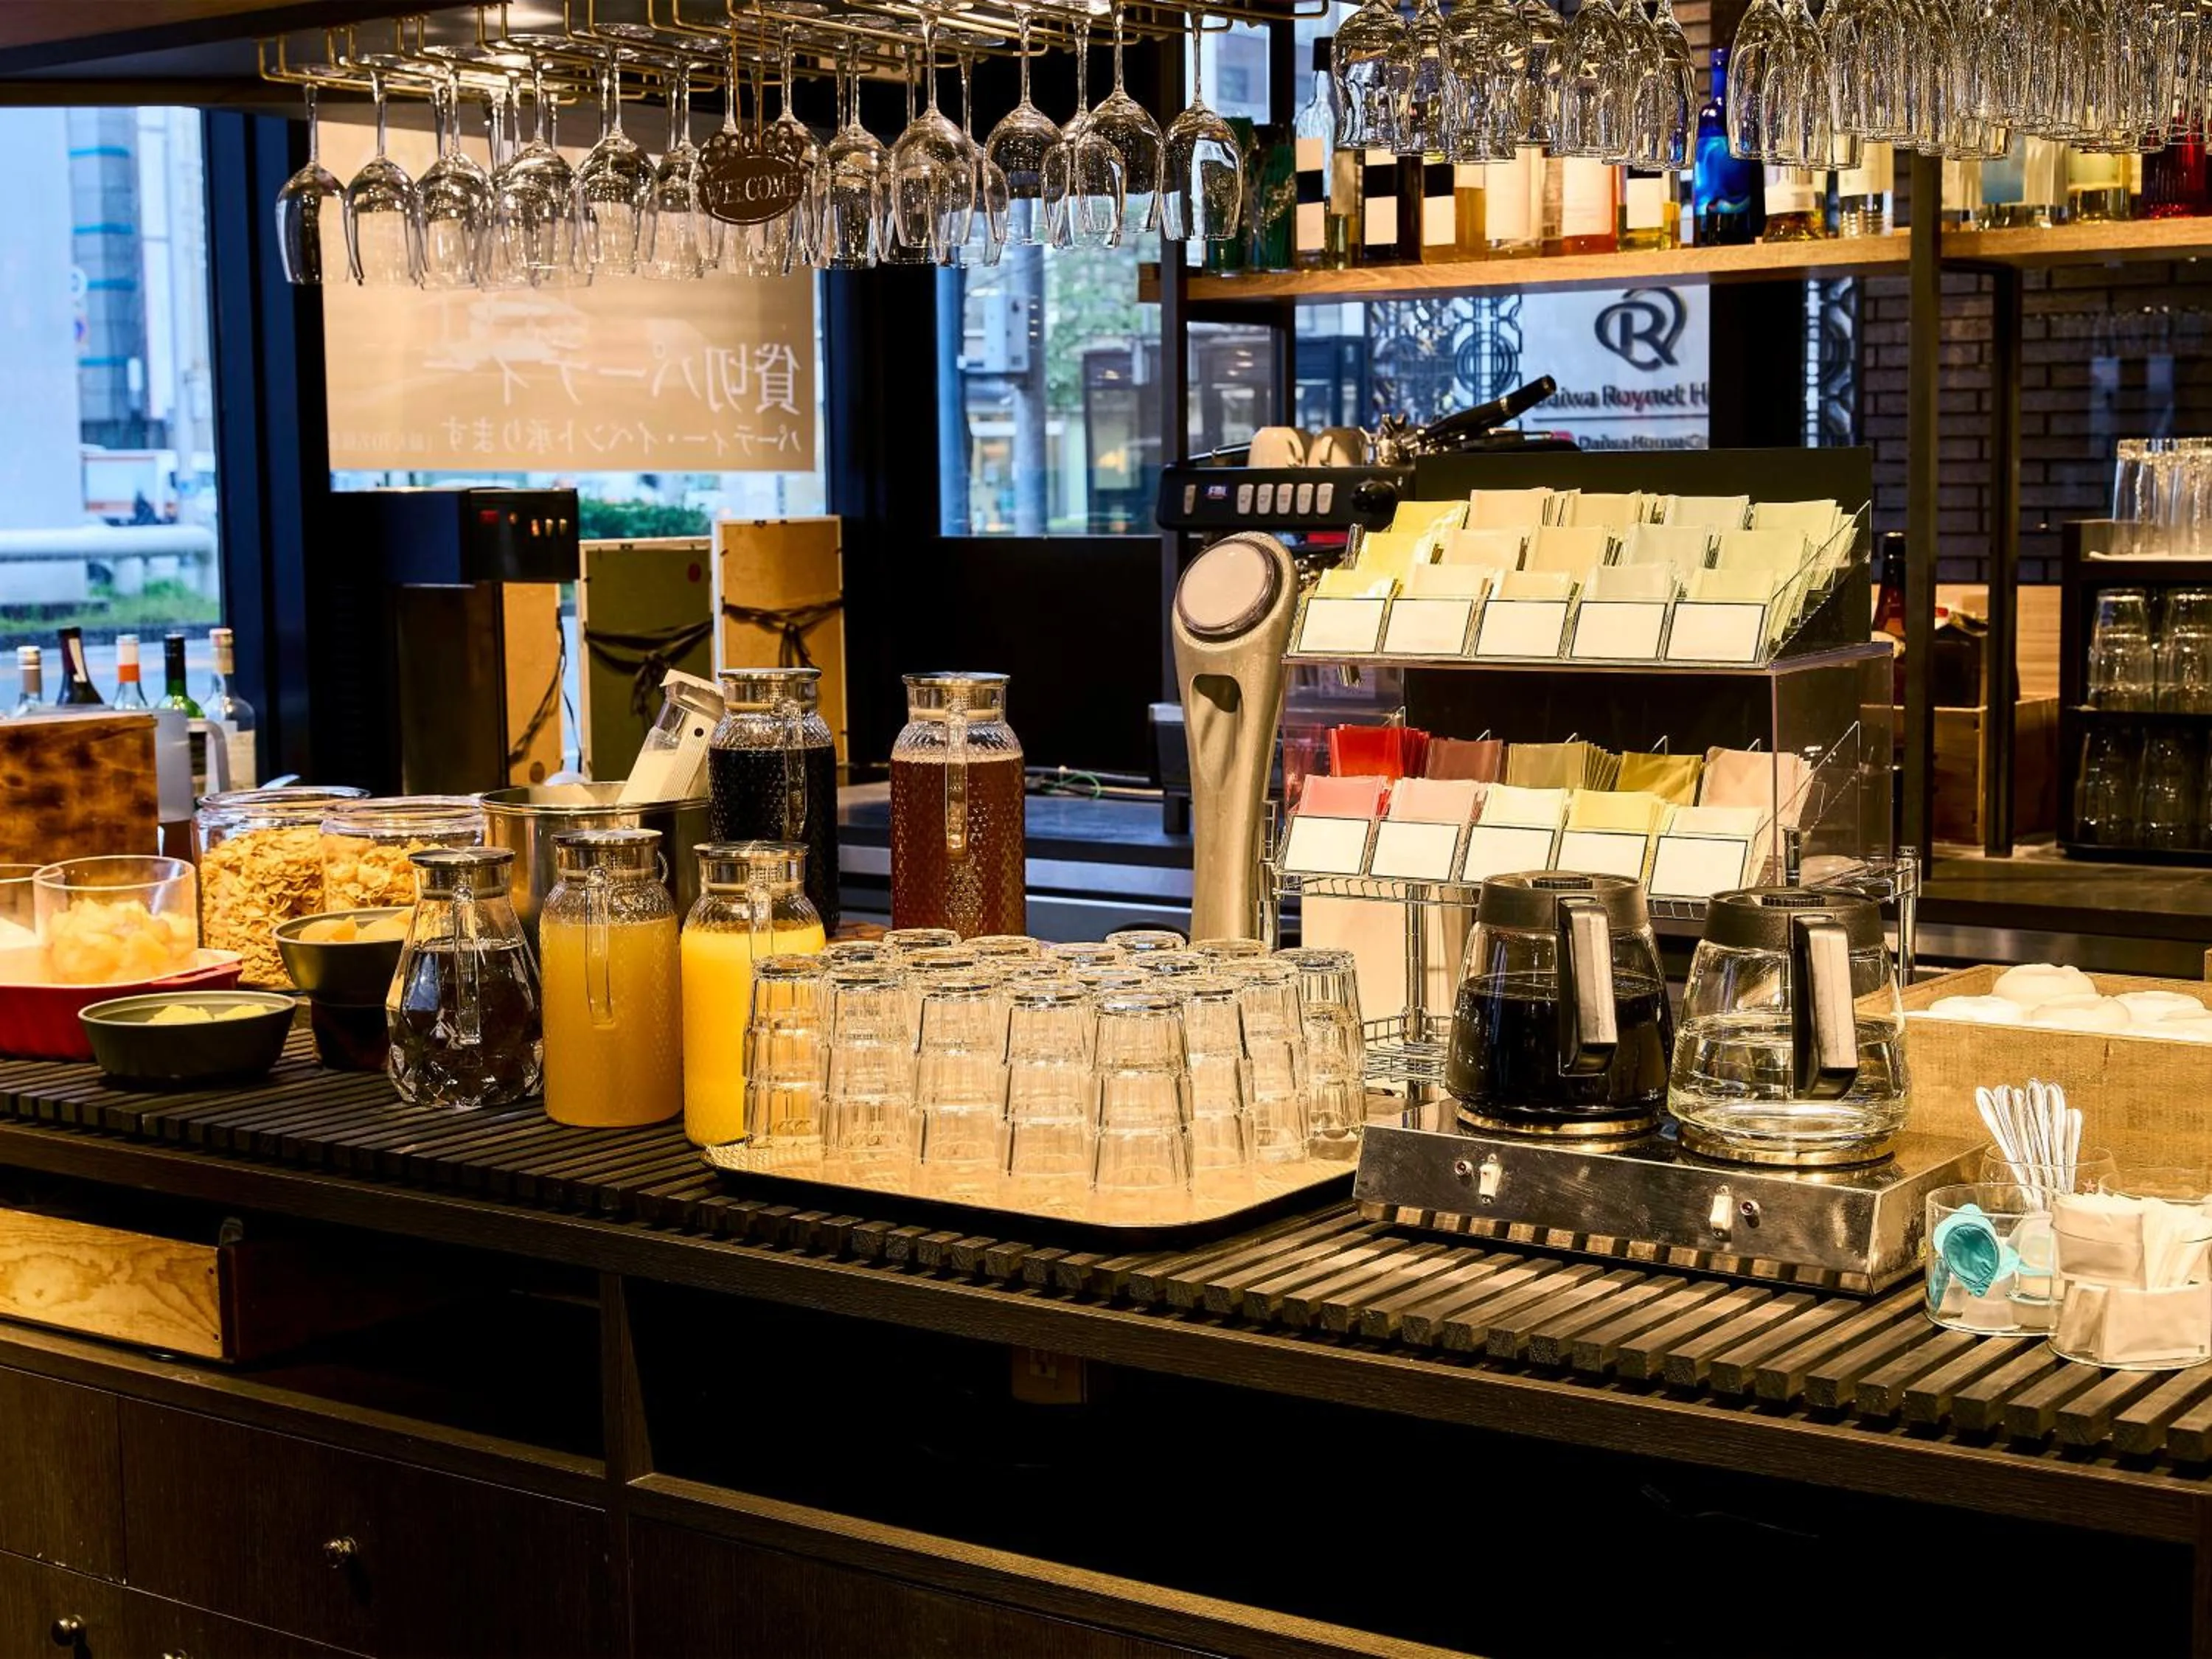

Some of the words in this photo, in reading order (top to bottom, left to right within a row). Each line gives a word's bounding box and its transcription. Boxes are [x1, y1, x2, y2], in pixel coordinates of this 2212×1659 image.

[1534, 386, 1599, 408] aiwa
[1602, 383, 1686, 413] Roynet
[1690, 381, 1708, 406] H
